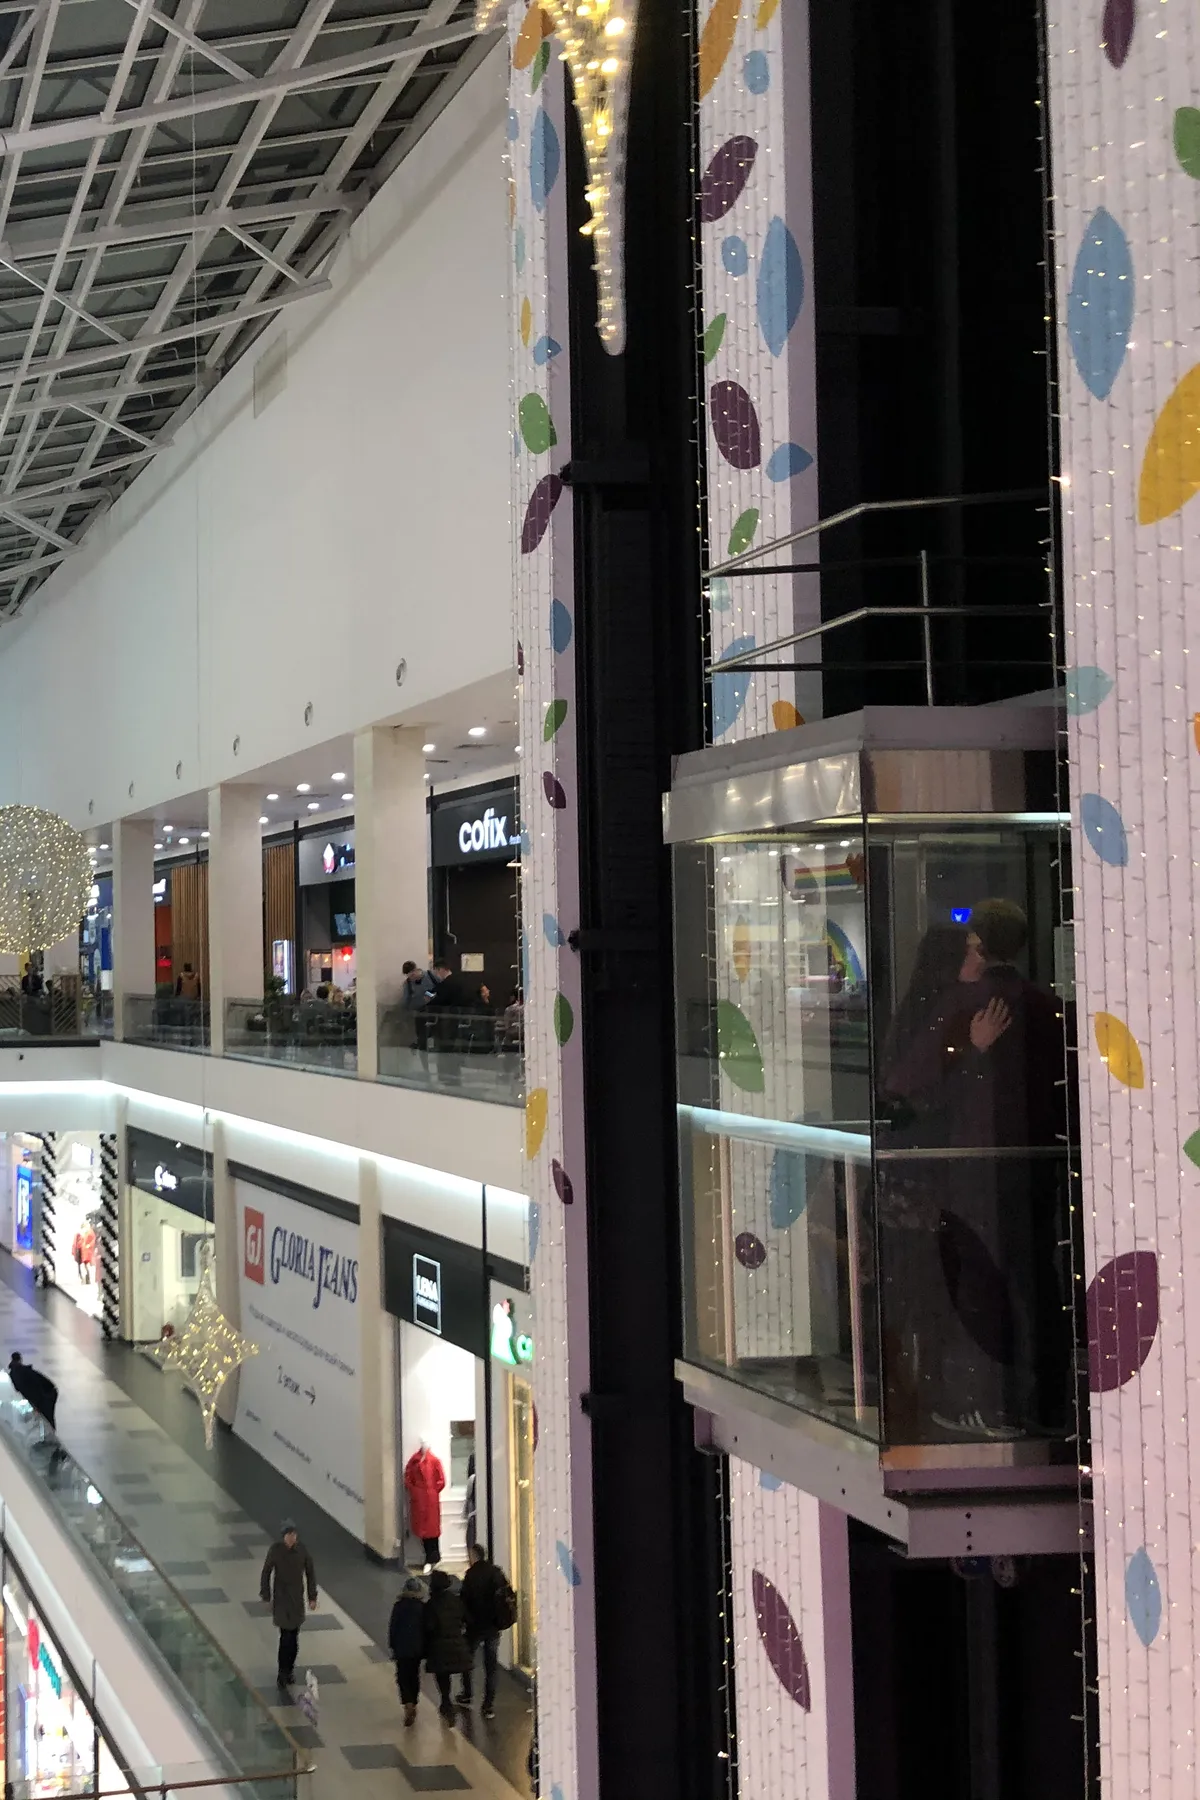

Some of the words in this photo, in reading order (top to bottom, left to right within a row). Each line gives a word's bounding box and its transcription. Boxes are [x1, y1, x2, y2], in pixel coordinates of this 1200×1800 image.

[459, 807, 508, 853] cofix
[271, 1226, 315, 1284] GLORIA
[312, 1245, 359, 1309] JEANS
